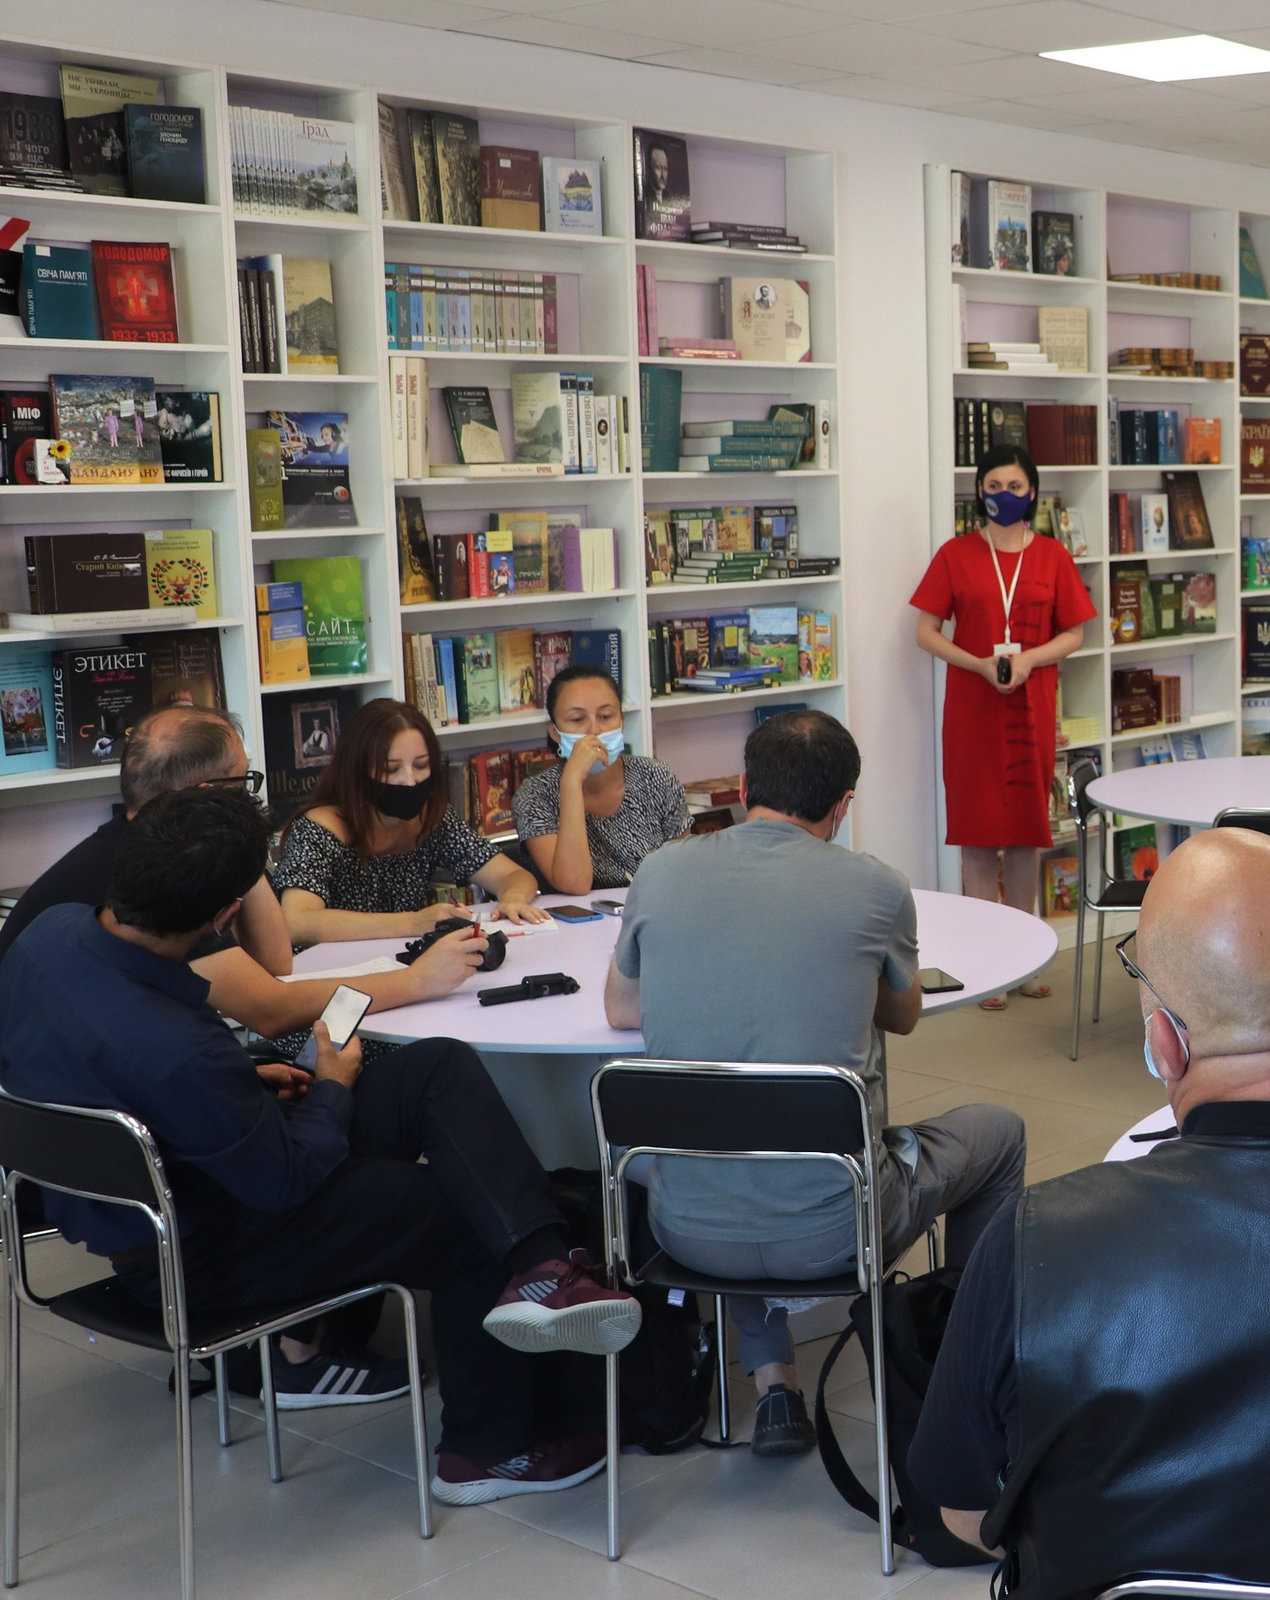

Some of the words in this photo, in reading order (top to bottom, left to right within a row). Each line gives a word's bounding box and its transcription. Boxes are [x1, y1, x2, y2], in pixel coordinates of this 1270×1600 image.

[150, 112, 194, 123] ГОЛОДОМОР
[302, 121, 330, 140] Град
[27, 153, 44, 164] ще
[99, 246, 167, 261] ГОЛОДОМОР
[37, 268, 58, 279] СВІЧА
[59, 270, 88, 281] ПАМ'ЯТІ
[16, 407, 41, 420] МІФ
[306, 617, 356, 637] САЙТ:
[74, 652, 147, 674] ЭТИКЕТ
[608, 633, 618, 685] ИНСЬКИЙ
[53, 667, 66, 743] ЭТИКЕТ
